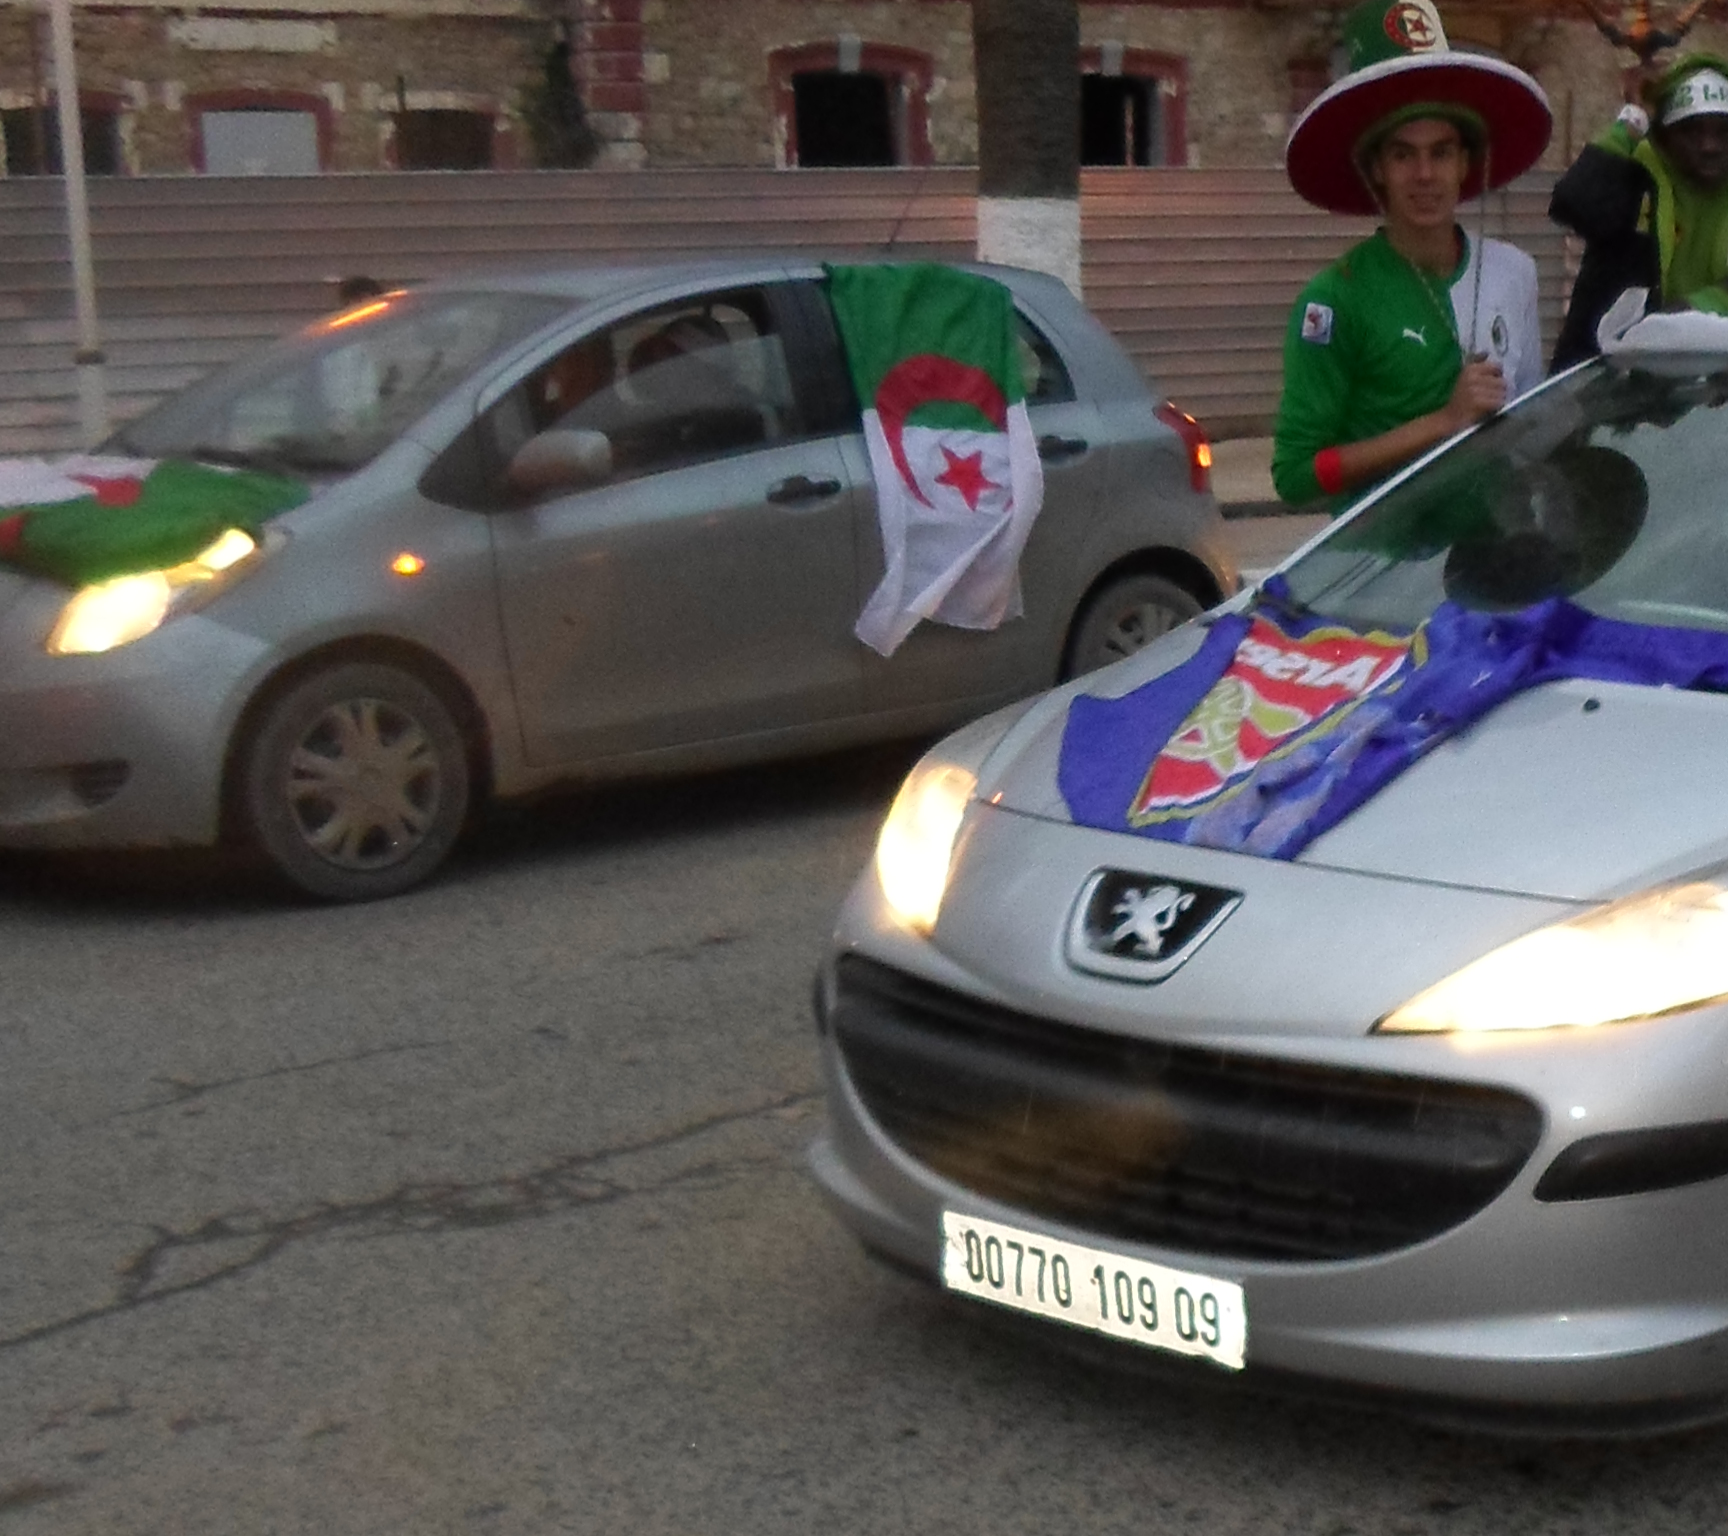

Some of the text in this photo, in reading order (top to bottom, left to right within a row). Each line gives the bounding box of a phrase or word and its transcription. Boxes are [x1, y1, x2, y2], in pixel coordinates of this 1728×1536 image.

[964, 1229, 1222, 1347] 00770 109 09
